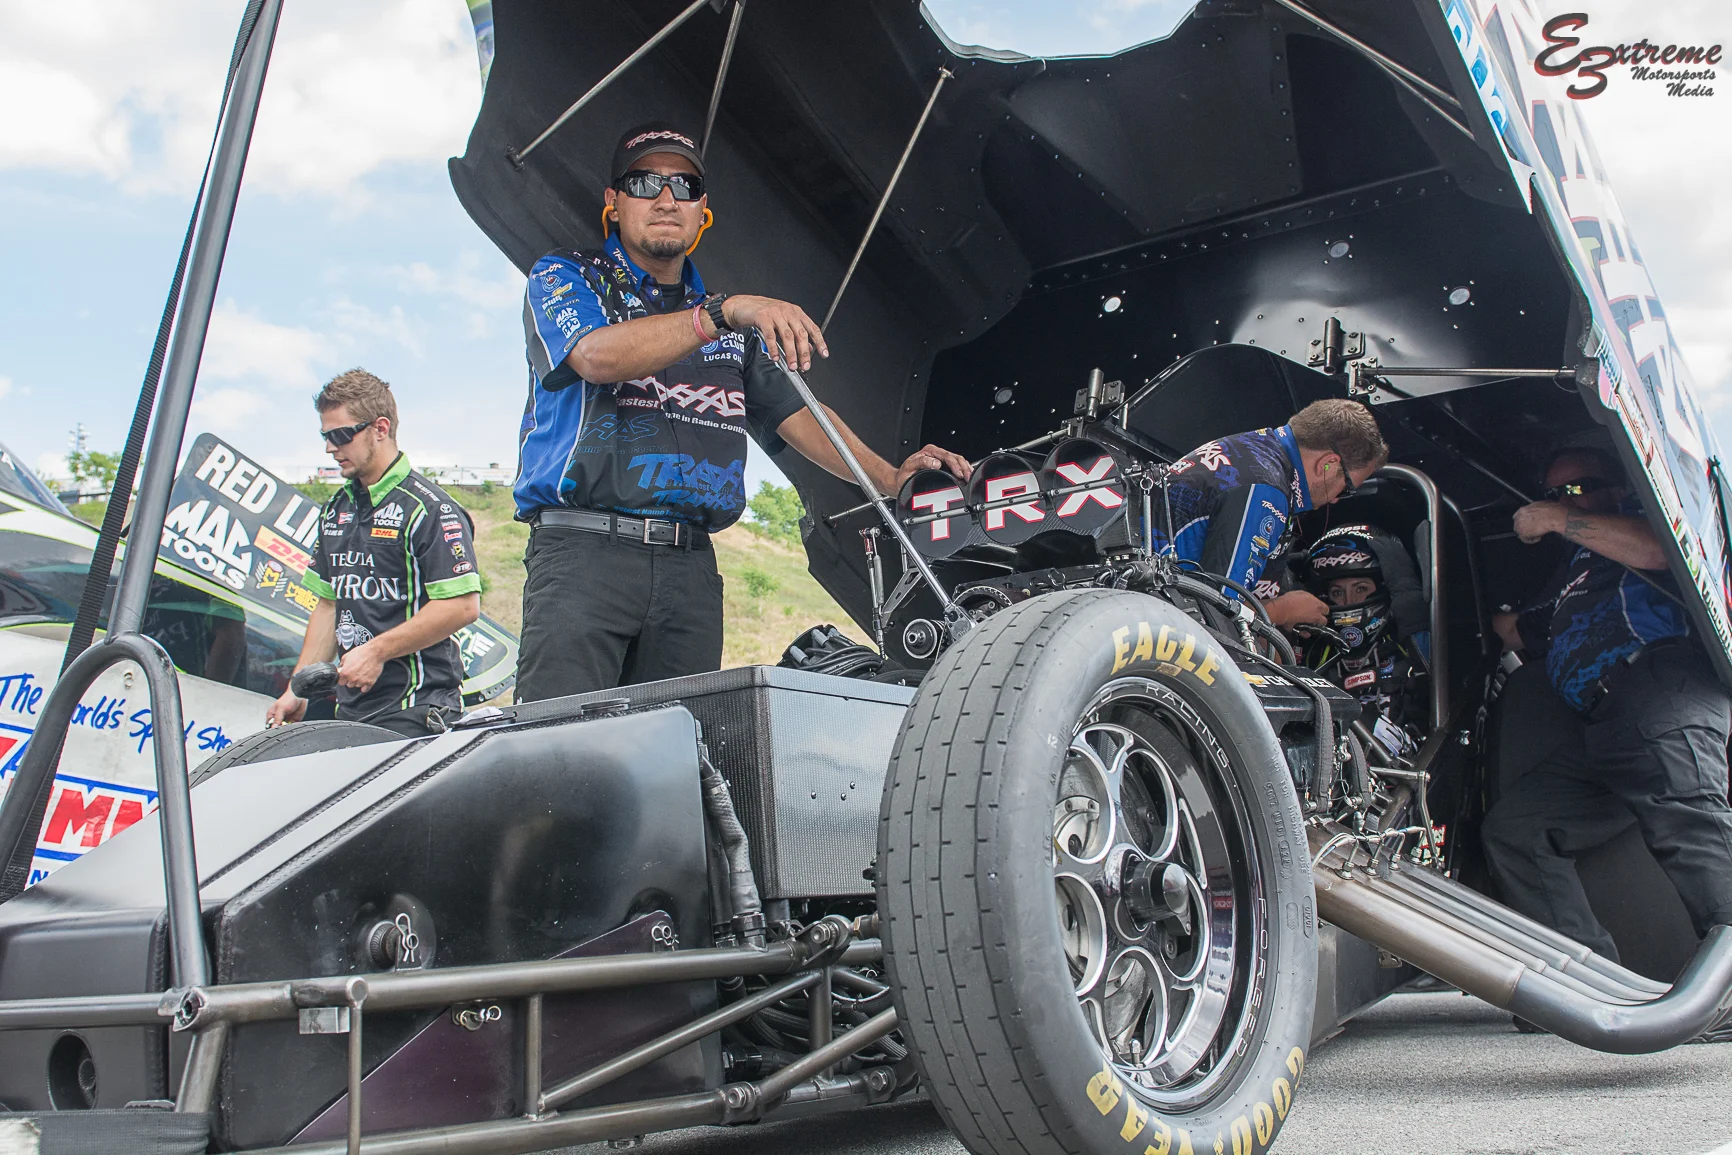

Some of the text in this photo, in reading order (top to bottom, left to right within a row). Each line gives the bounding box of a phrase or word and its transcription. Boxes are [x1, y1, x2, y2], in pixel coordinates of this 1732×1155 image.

[703, 353, 743, 364] LUCAS OIL
[722, 339, 745, 353] CLUB
[691, 417, 719, 429] Radio
[195, 443, 278, 514] RED
[373, 502, 404, 520] MAC
[374, 519, 402, 527] TOOLS
[163, 500, 253, 576] MAC
[375, 529, 394, 537] DHL
[161, 527, 247, 590] TOOLS
[267, 538, 310, 570] DH
[1364, 618, 1387, 633] PEAK
[1111, 622, 1220, 686] EAGLE
[1347, 674, 1371, 686] SIMPSON
[0, 673, 44, 714] The
[70, 695, 126, 730] orld's
[1146, 682, 1230, 769] RACING
[1287, 805, 1302, 846] HIGHWAY
[1236, 897, 1268, 1056] FORGED
